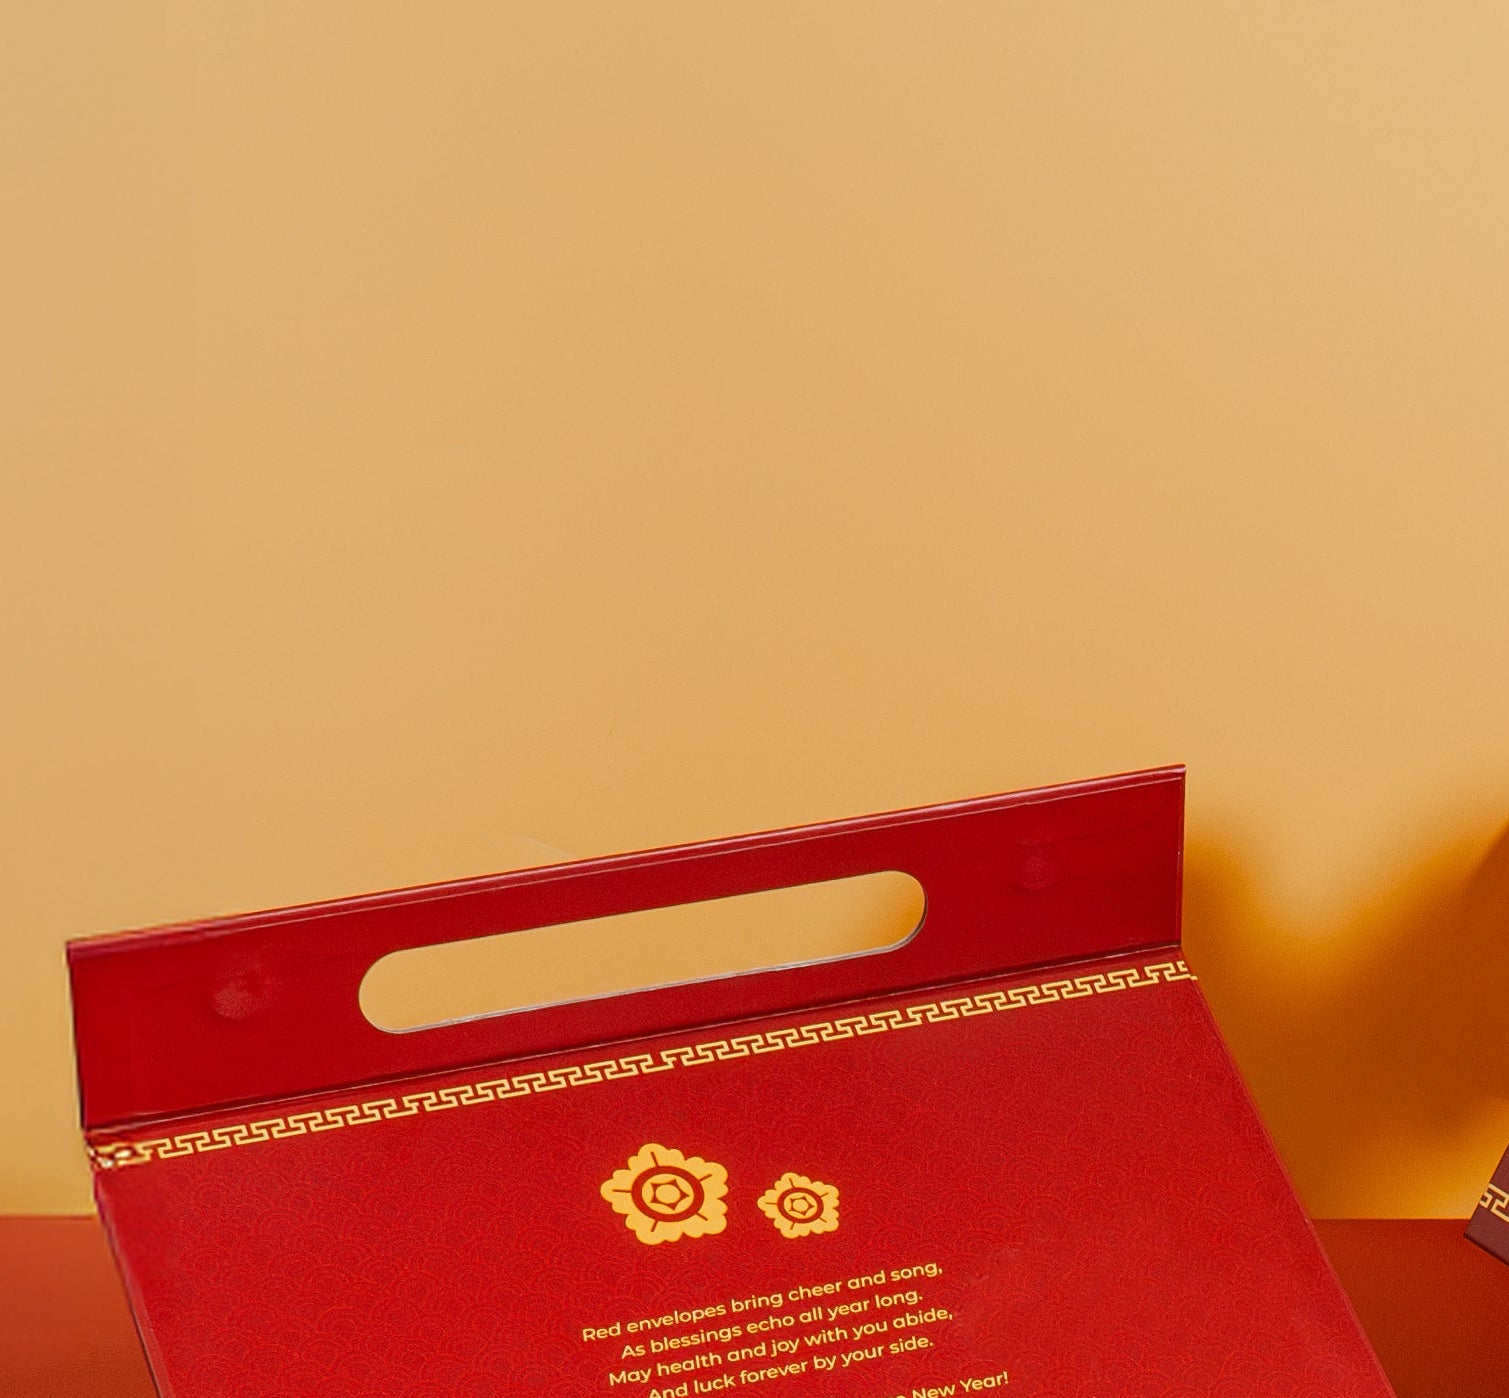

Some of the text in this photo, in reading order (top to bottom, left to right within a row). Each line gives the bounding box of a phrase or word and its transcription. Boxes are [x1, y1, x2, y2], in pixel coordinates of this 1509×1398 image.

[582, 1262, 943, 1342] Red envelopes bring cheer and song,
[621, 1290, 923, 1360] As blessings echo all year long.
[608, 1307, 953, 1387] May health and joy with you abide,
[693, 1373, 736, 1394] luck
[739, 1361, 809, 1385] forever
[813, 1355, 837, 1371] by
[840, 1345, 885, 1368] your
[888, 1335, 934, 1355] side.
[959, 1370, 1009, 1393] Year!
